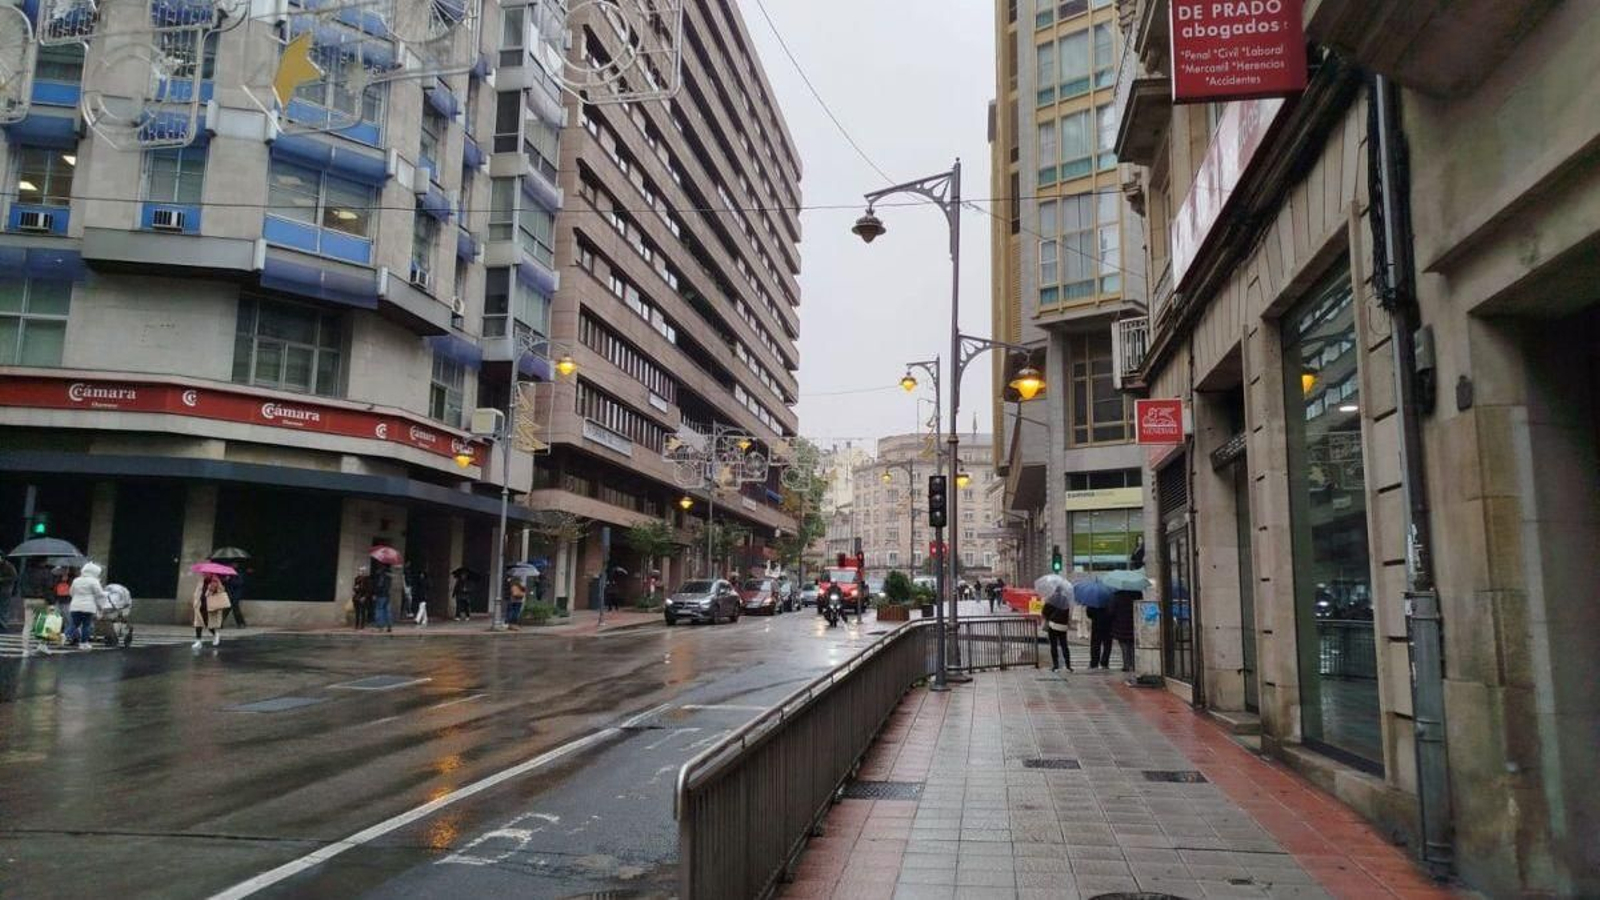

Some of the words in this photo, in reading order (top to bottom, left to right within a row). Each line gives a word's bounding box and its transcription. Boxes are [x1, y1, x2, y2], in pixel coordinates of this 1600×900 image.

[1178, 5, 1203, 20] DE
[1212, 0, 1282, 19] PRADO
[1182, 19, 1280, 39] abogados
